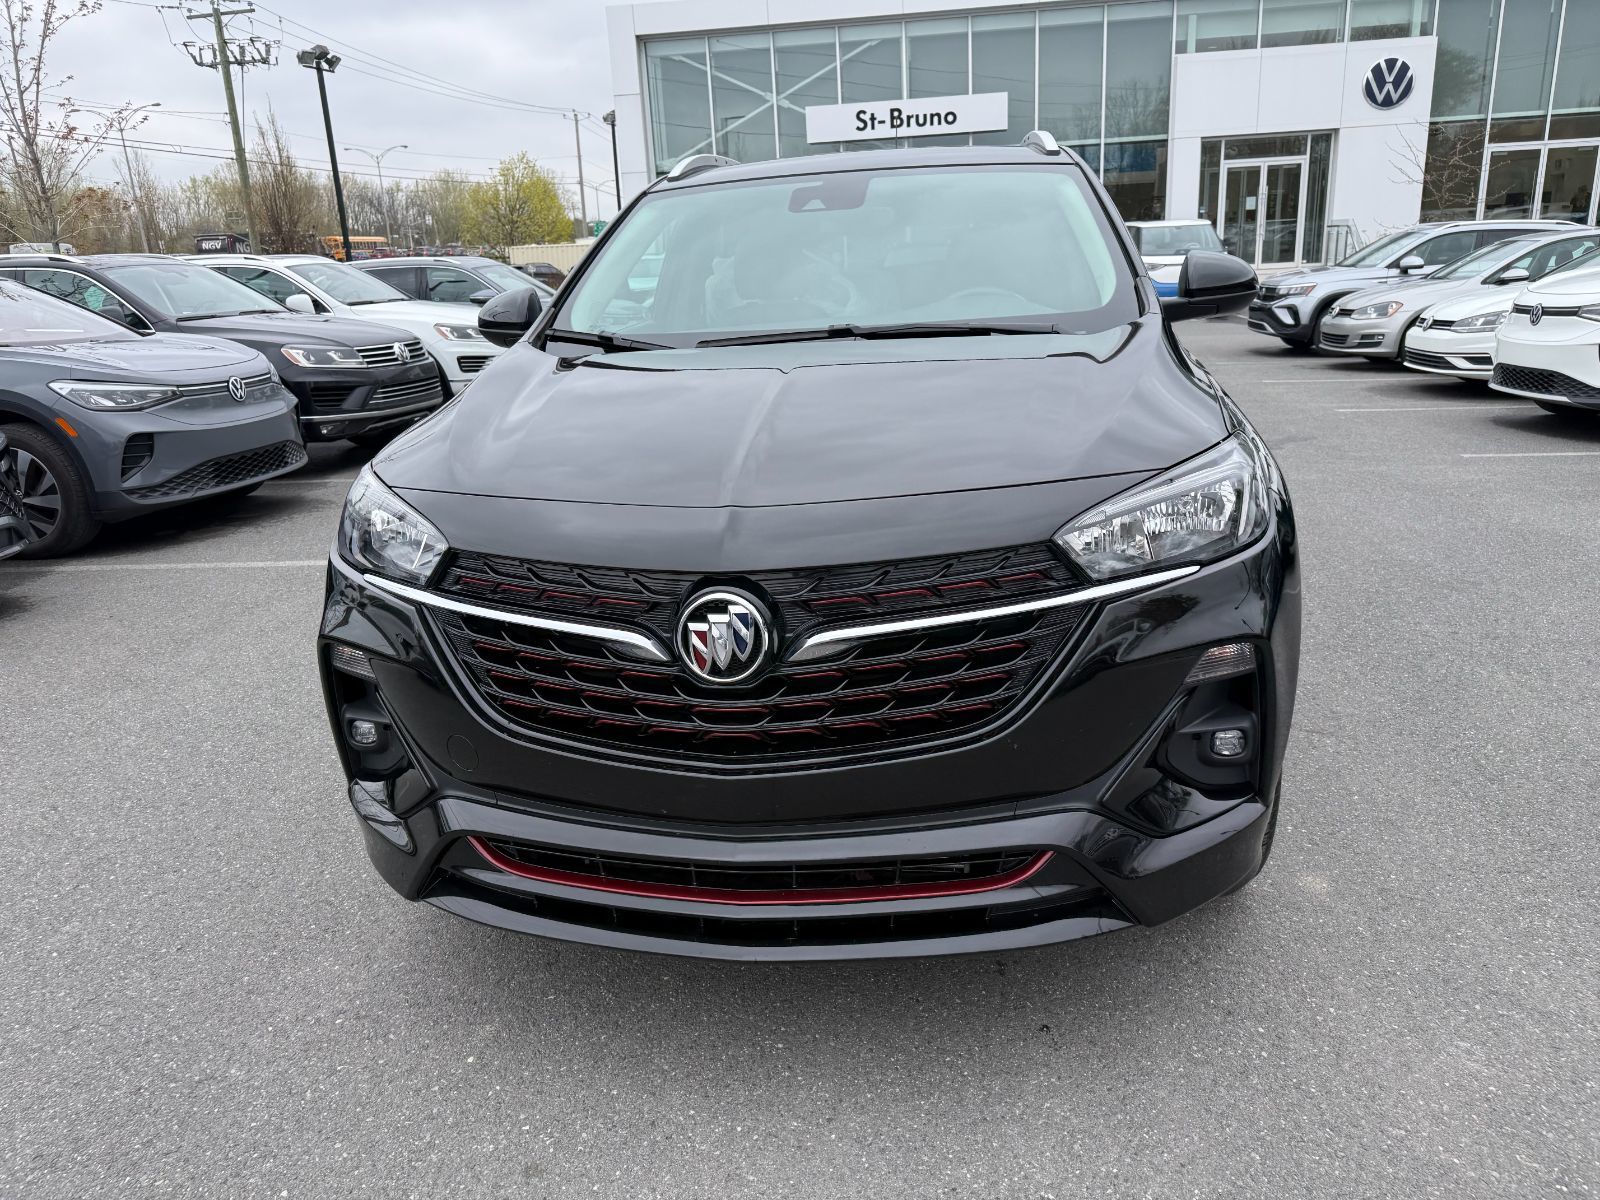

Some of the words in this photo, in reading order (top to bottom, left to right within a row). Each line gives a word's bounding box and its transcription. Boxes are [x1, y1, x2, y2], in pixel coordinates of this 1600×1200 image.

[1364, 57, 1414, 107] VW
[855, 107, 957, 131] St-Bruno
[202, 240, 221, 250] NGV
[235, 241, 251, 253] NG
[230, 377, 246, 400] VW
